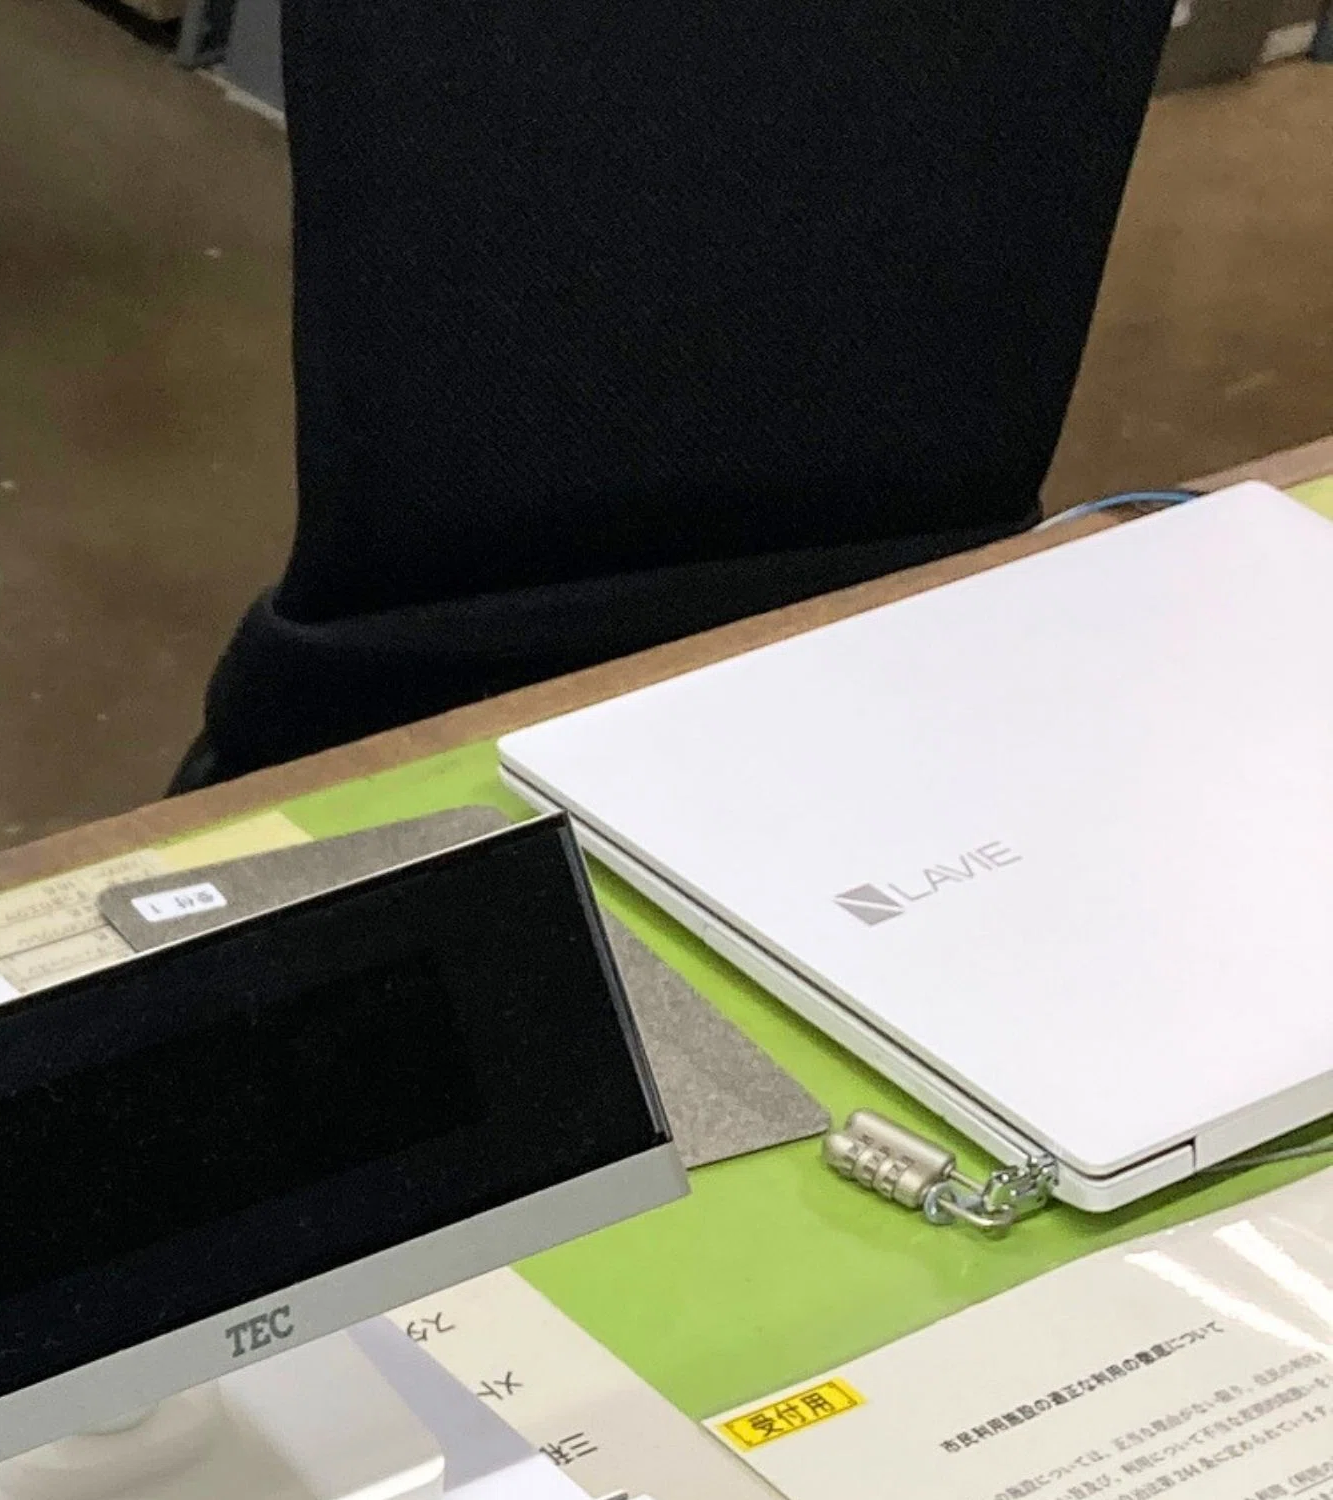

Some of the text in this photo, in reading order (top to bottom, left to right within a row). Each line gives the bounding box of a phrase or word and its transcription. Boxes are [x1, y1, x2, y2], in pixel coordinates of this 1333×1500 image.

[886, 840, 1023, 902] LAVIE
[225, 1304, 295, 1359] TEC
[748, 1391, 836, 1437] 受付用
